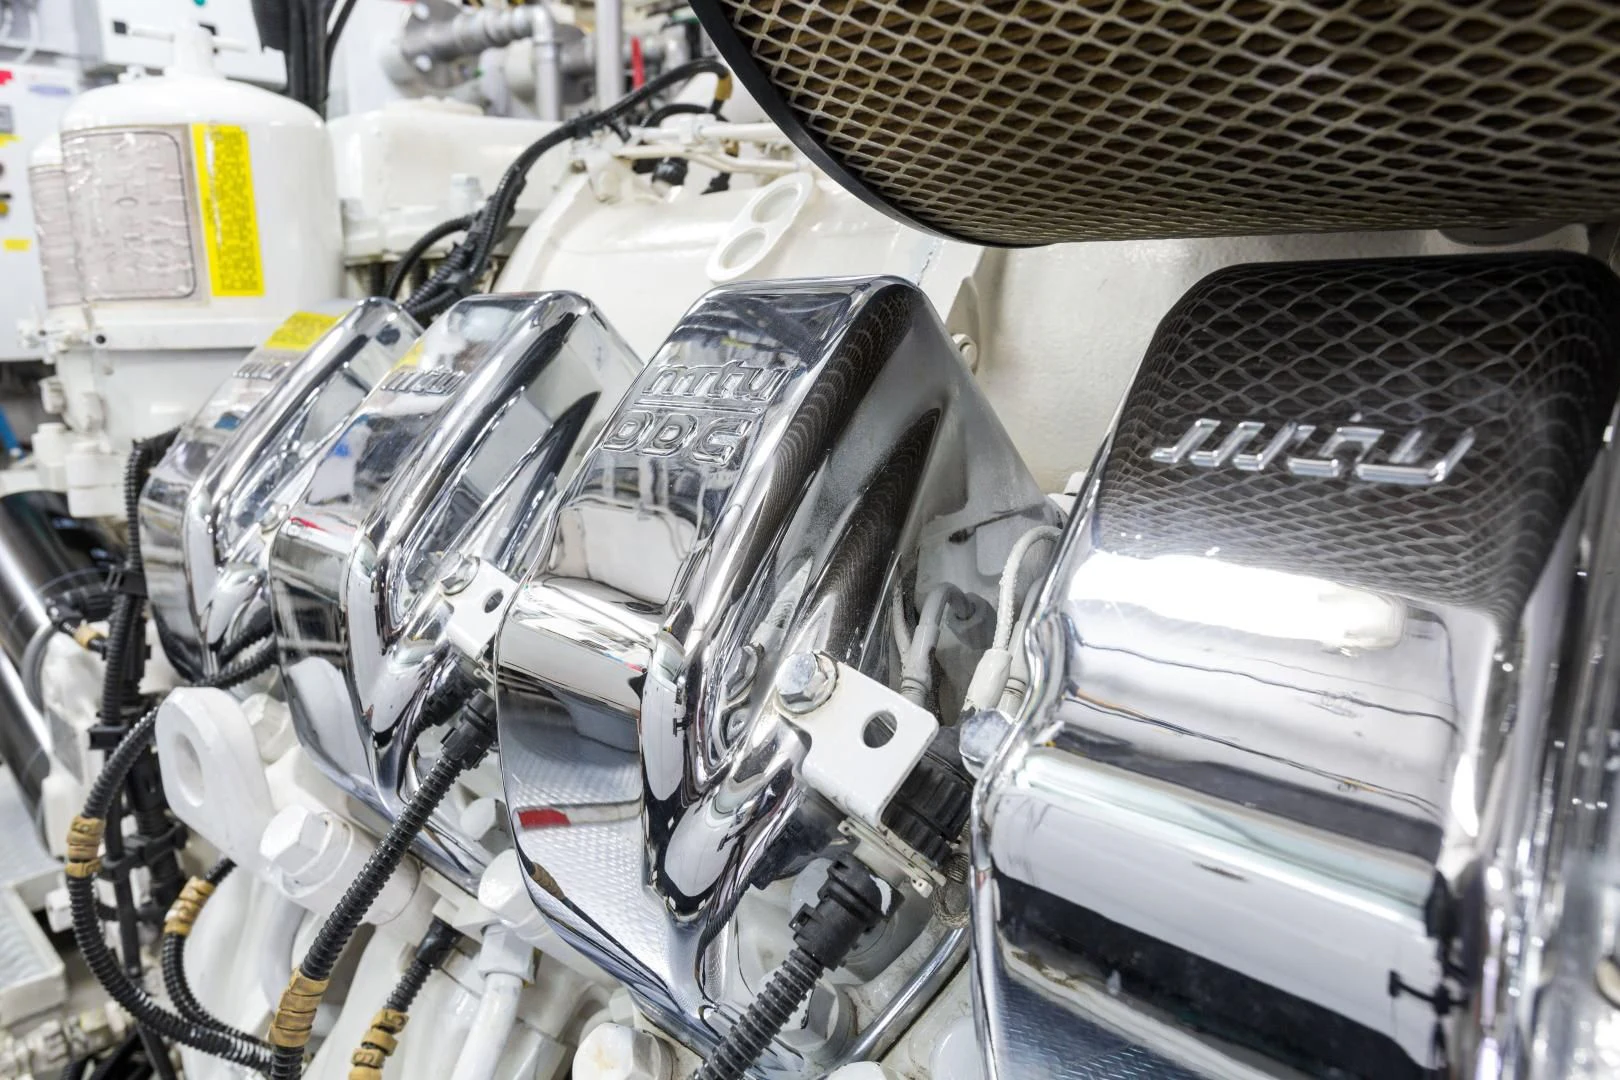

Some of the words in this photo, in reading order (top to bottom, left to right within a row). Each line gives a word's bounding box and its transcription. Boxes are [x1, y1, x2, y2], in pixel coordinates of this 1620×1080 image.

[641, 360, 797, 402] mtu
[601, 411, 752, 465] DDC
[1150, 411, 1476, 486] mtu
